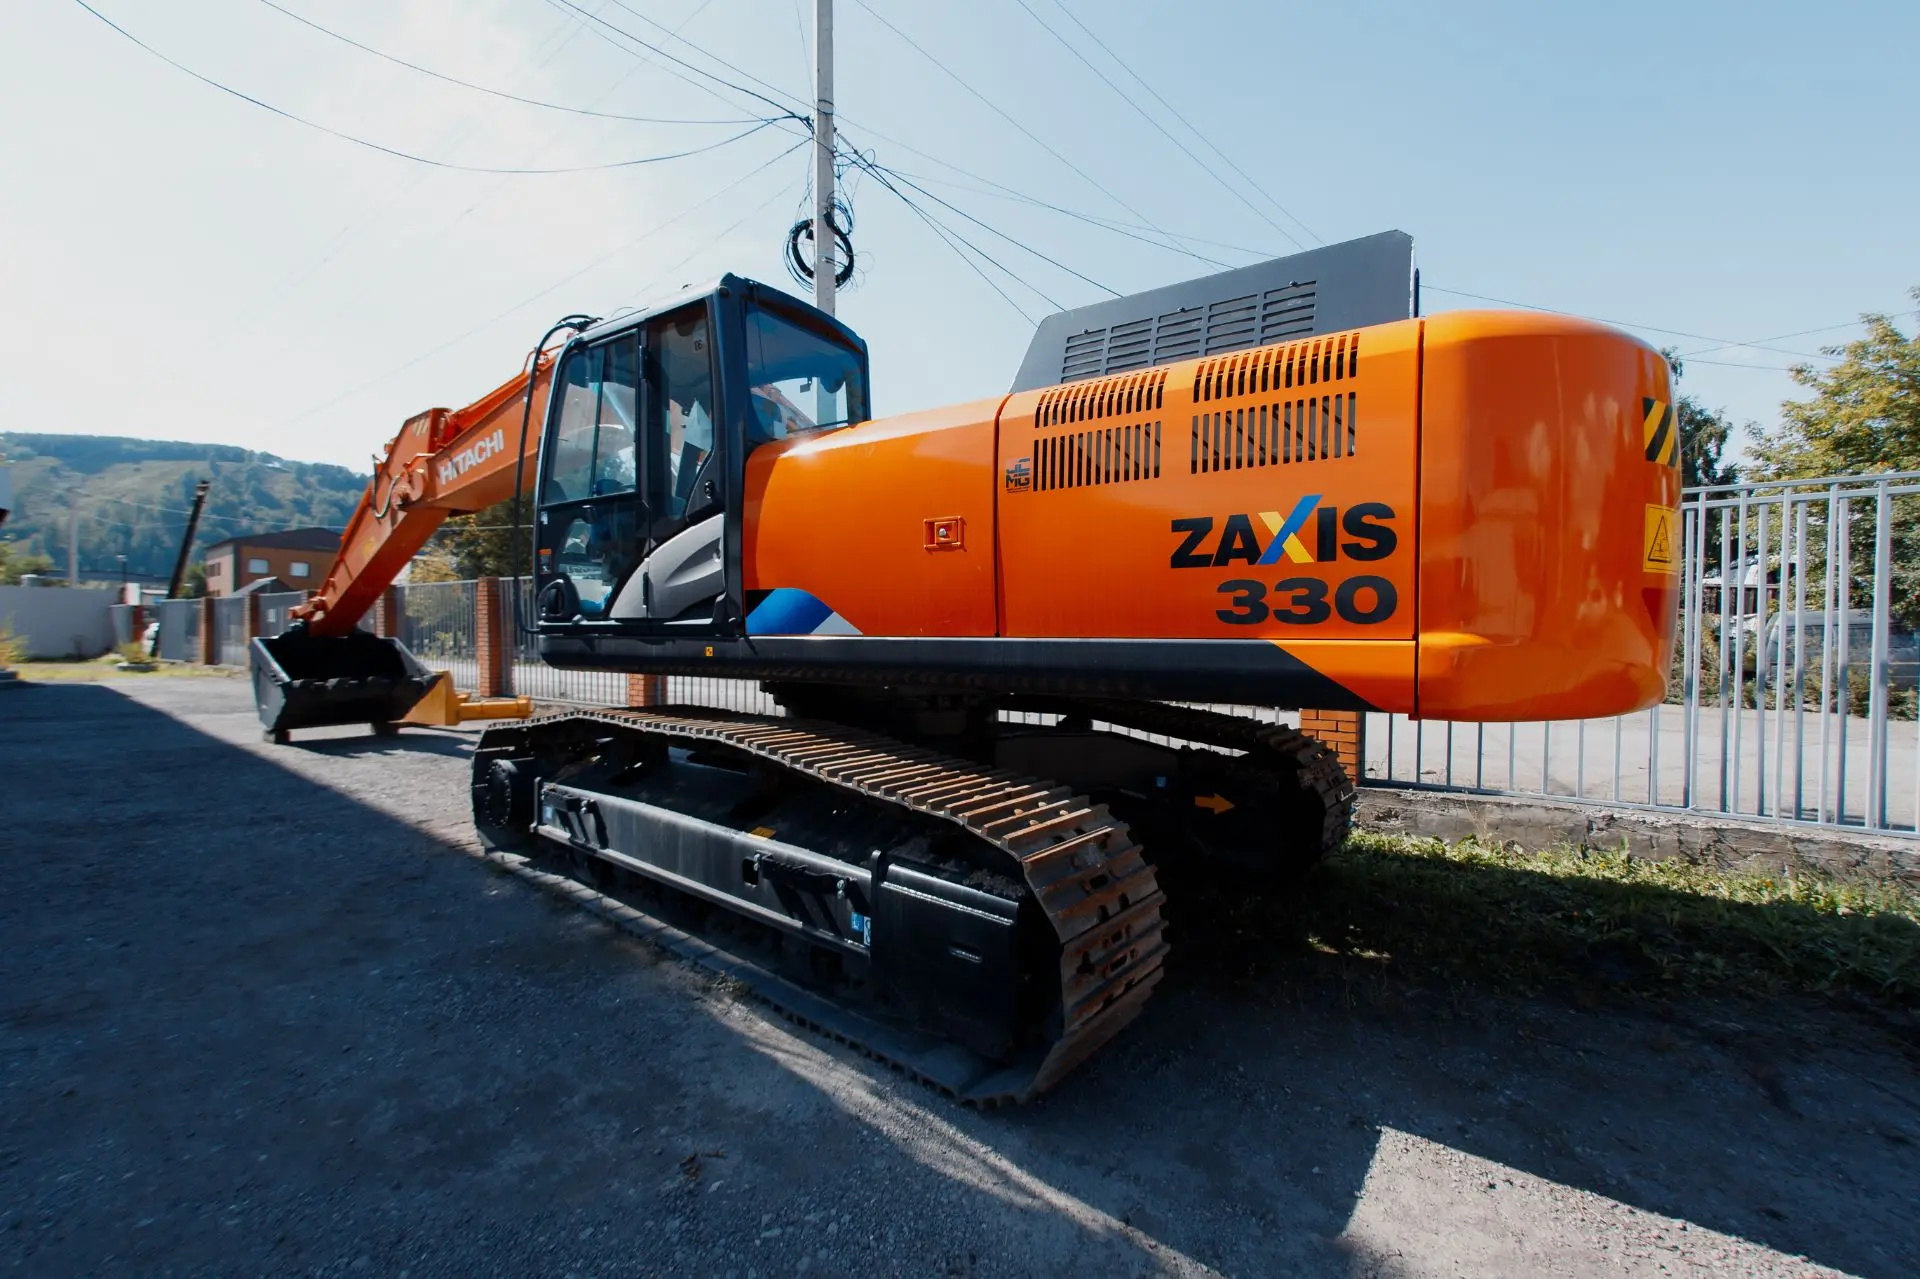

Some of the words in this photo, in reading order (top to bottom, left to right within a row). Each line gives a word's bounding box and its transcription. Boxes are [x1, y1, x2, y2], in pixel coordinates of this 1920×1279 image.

[440, 429, 504, 485] HITACHI
[1170, 494, 1398, 568] ZAXIS
[1215, 575, 1398, 625] 330
